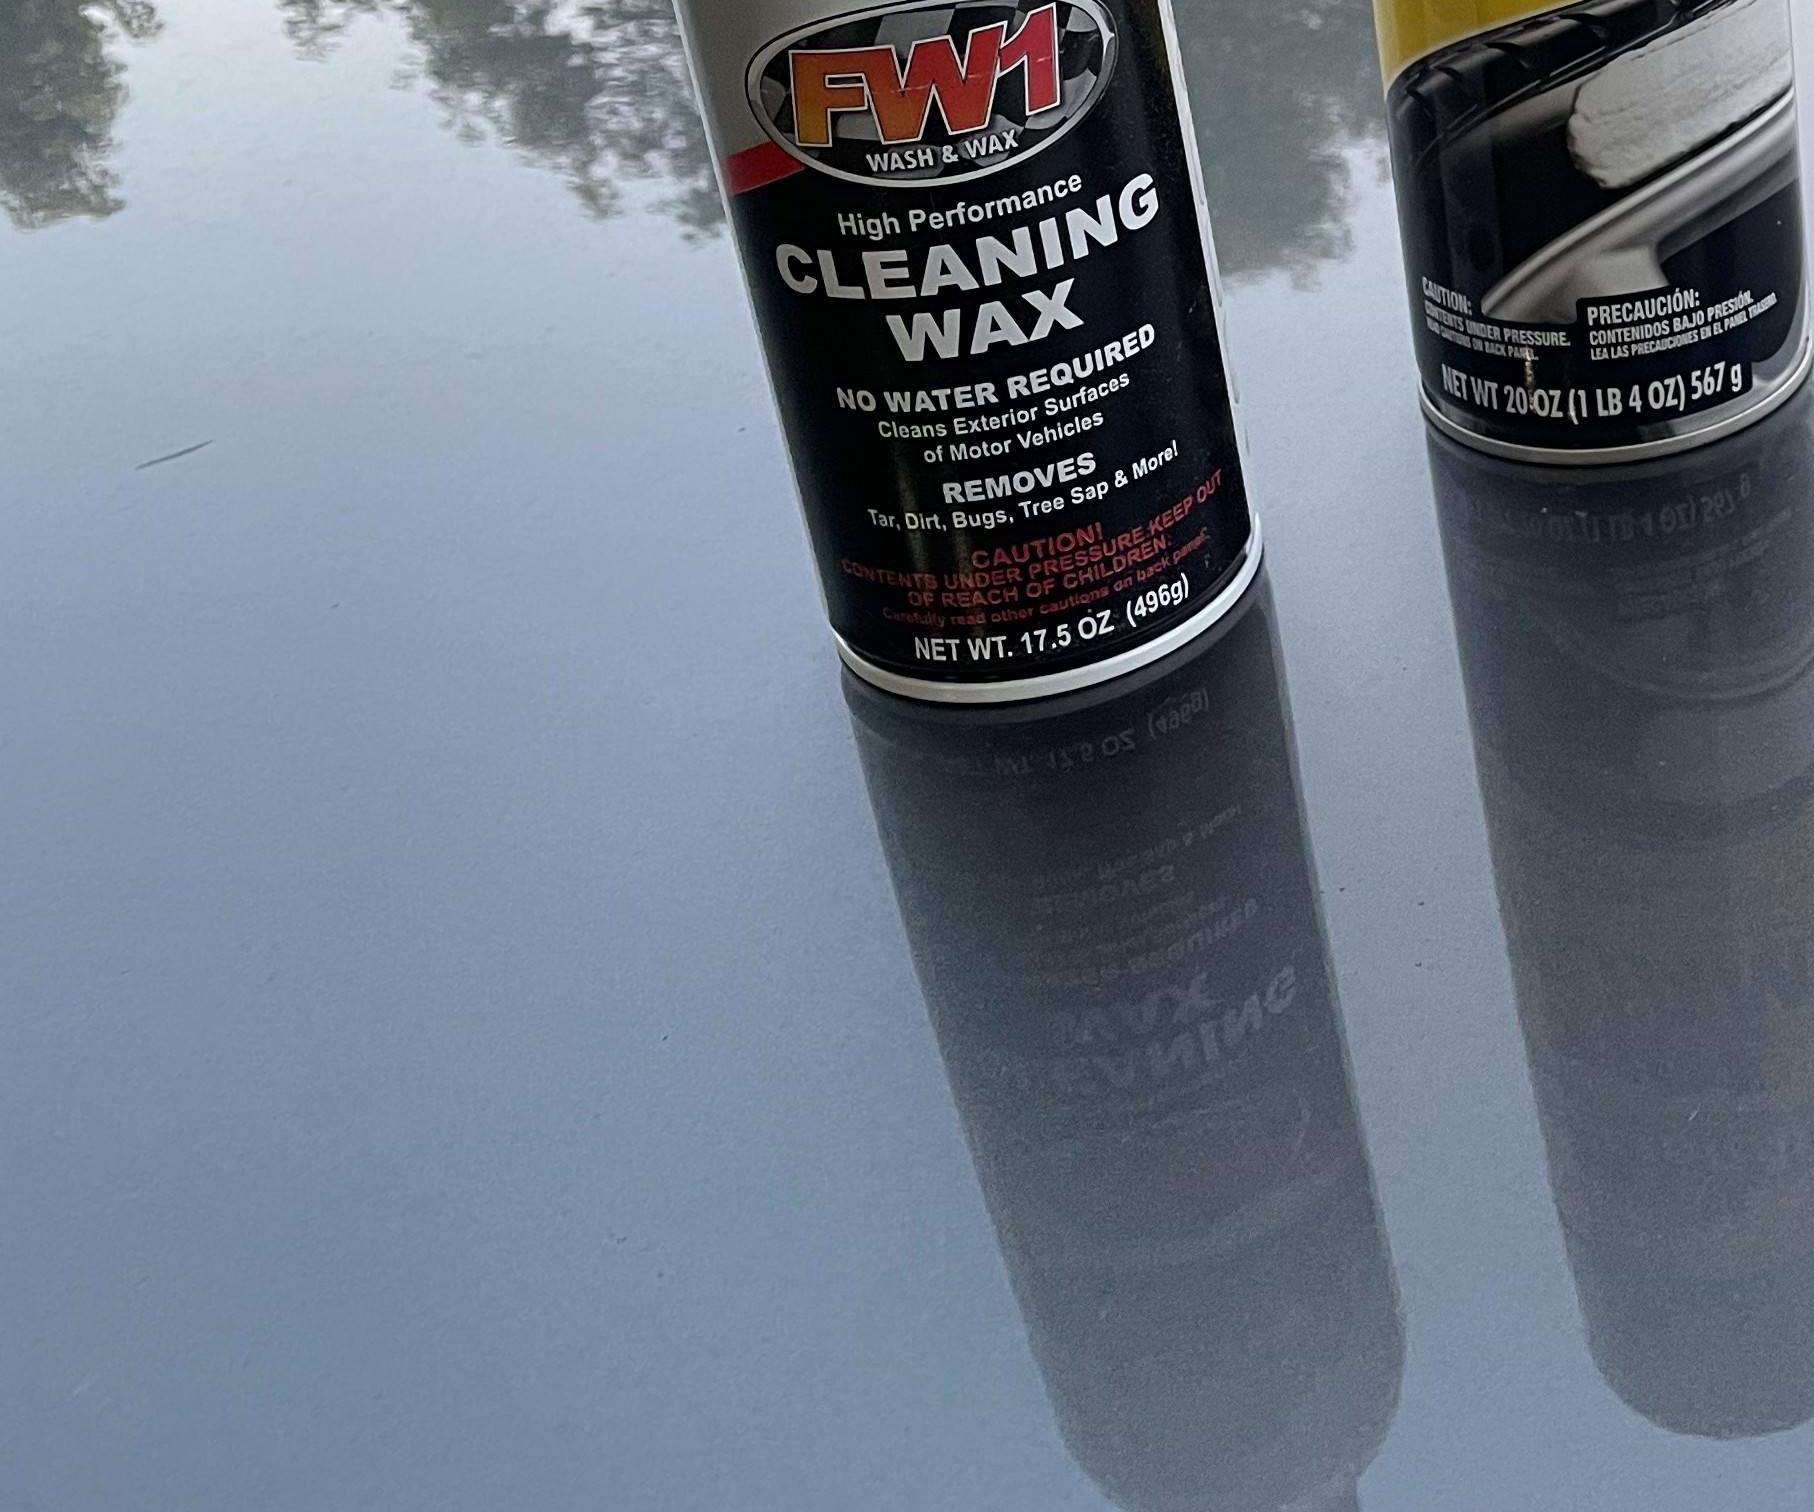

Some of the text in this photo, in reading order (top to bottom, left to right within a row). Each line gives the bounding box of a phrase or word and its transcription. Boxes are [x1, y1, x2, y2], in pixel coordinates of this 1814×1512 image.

[788, 1, 1061, 149] FW1
[866, 129, 1019, 174] WASH & WAX
[775, 172, 1160, 300] CLEANING
[838, 173, 1083, 242] High Performance
[886, 278, 1085, 362] WAX
[1422, 276, 1472, 316] CAUTION:
[1424, 299, 1571, 347] CONTENTS UNDER PRESSURE.
[1586, 287, 1701, 327] PRECAUCIÓN:
[1484, 341, 1508, 357] BACK
[1589, 320, 1671, 346] CONTENIDOS
[1672, 310, 1705, 333] BAJO
[1590, 347, 1610, 361] LEA
[1610, 344, 1630, 359] LAS
[1631, 329, 1699, 357] PRECAUCIONES
[1699, 326, 1713, 340] EN
[1713, 322, 1724, 336] EL
[1724, 312, 1749, 332] PANEL
[836, 323, 1156, 414] NO WATER REQUIRED
[1441, 361, 1743, 425] NET WT 20 OZ (1 LB 4 OZ) 567 g
[877, 372, 1131, 441] Cleans Exterior Surfaces
[923, 411, 1105, 465] of Motor Vehicles
[867, 440, 1179, 532] Tar, Dirt, Bugs, Tree Sap & More!
[942, 451, 1098, 505] REMOVES
[841, 557, 937, 590] CONTENTS
[943, 566, 1021, 590] UNDER
[1196, 468, 1223, 504] OUT
[970, 521, 1104, 570] CAUTION!
[883, 606, 945, 629] Carefully
[951, 610, 987, 626] read
[991, 604, 1034, 622] other
[1040, 585, 1111, 614] cautions
[1113, 577, 1134, 594] on
[1137, 555, 1171, 584] back
[907, 590, 935, 607] OF
[941, 583, 1019, 609] REACH
[1025, 578, 1055, 599] OF
[914, 572, 1190, 661] NET WT. 17.5 OZ (496g)
